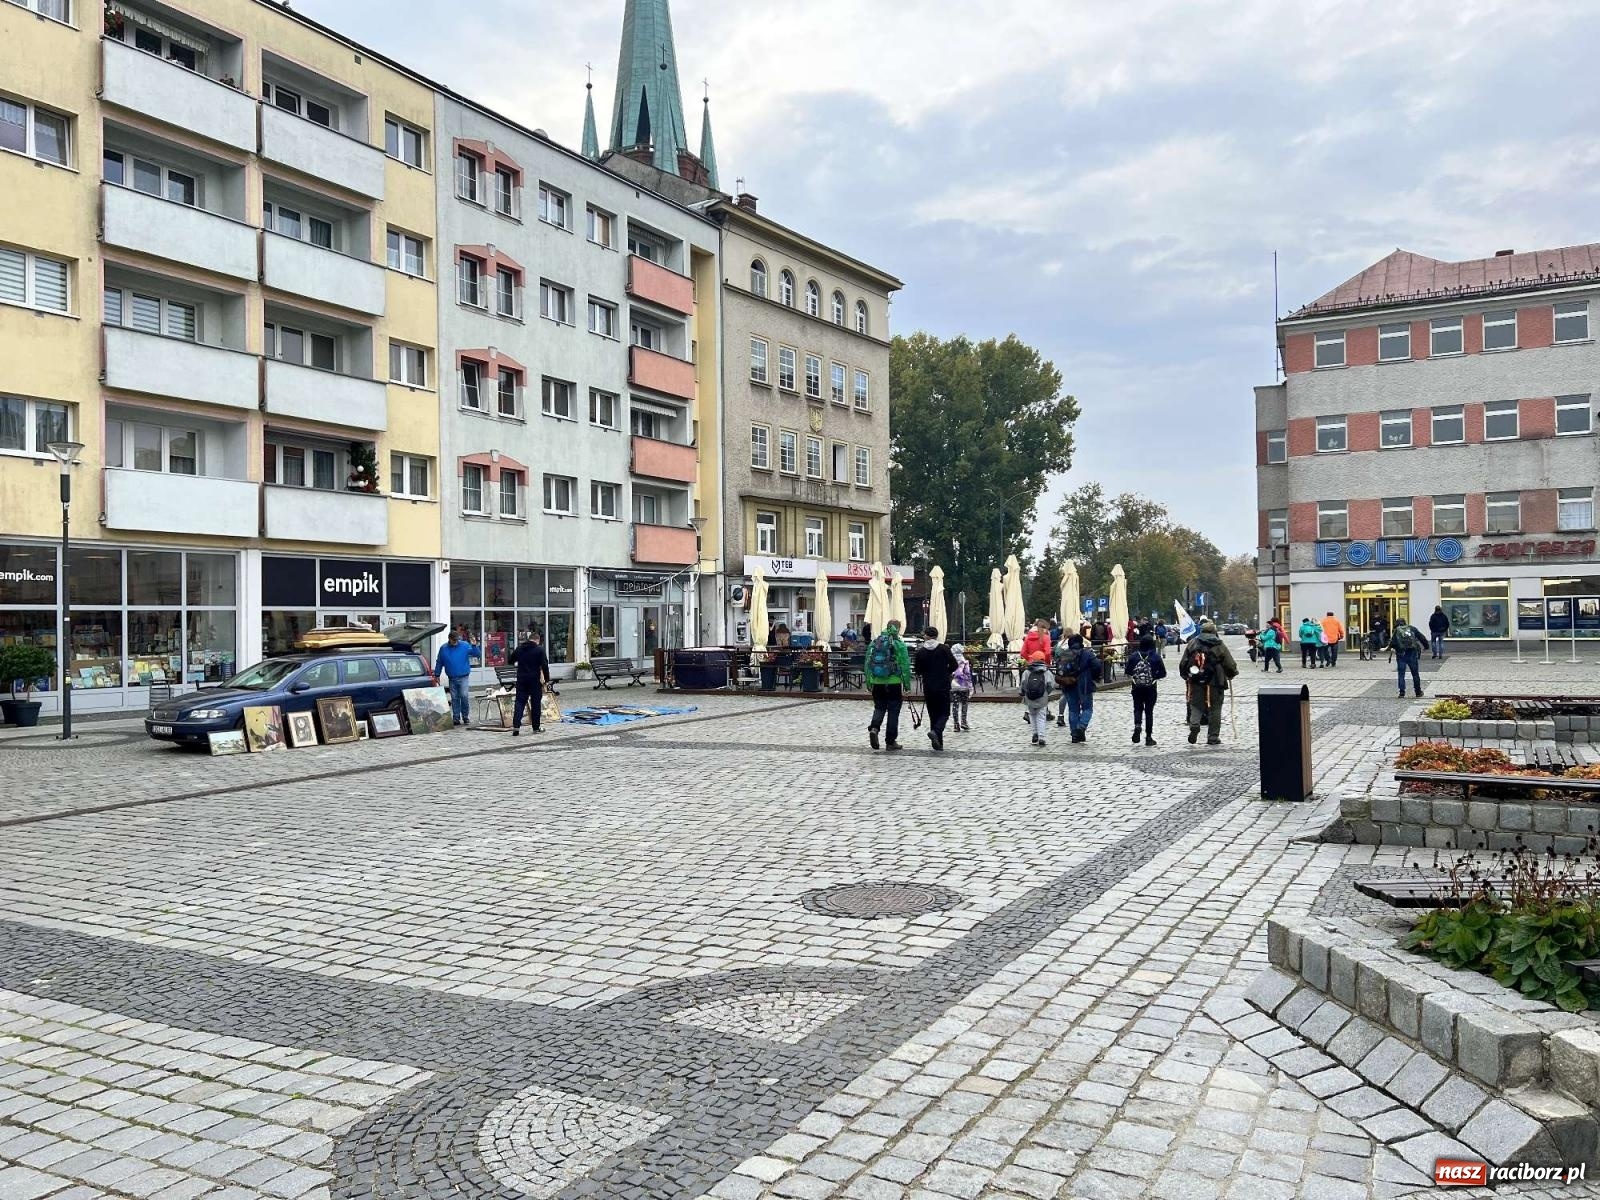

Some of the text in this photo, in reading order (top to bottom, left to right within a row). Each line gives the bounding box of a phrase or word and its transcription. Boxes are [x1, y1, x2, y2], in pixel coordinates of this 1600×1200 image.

[1315, 537, 1596, 567] BOLKO zaprasza
[781, 561, 793, 569] TEB
[0, 568, 54, 582] empik.com
[324, 571, 379, 596] empik
[1086, 599, 1093, 608] P
[1099, 598, 1106, 606] P
